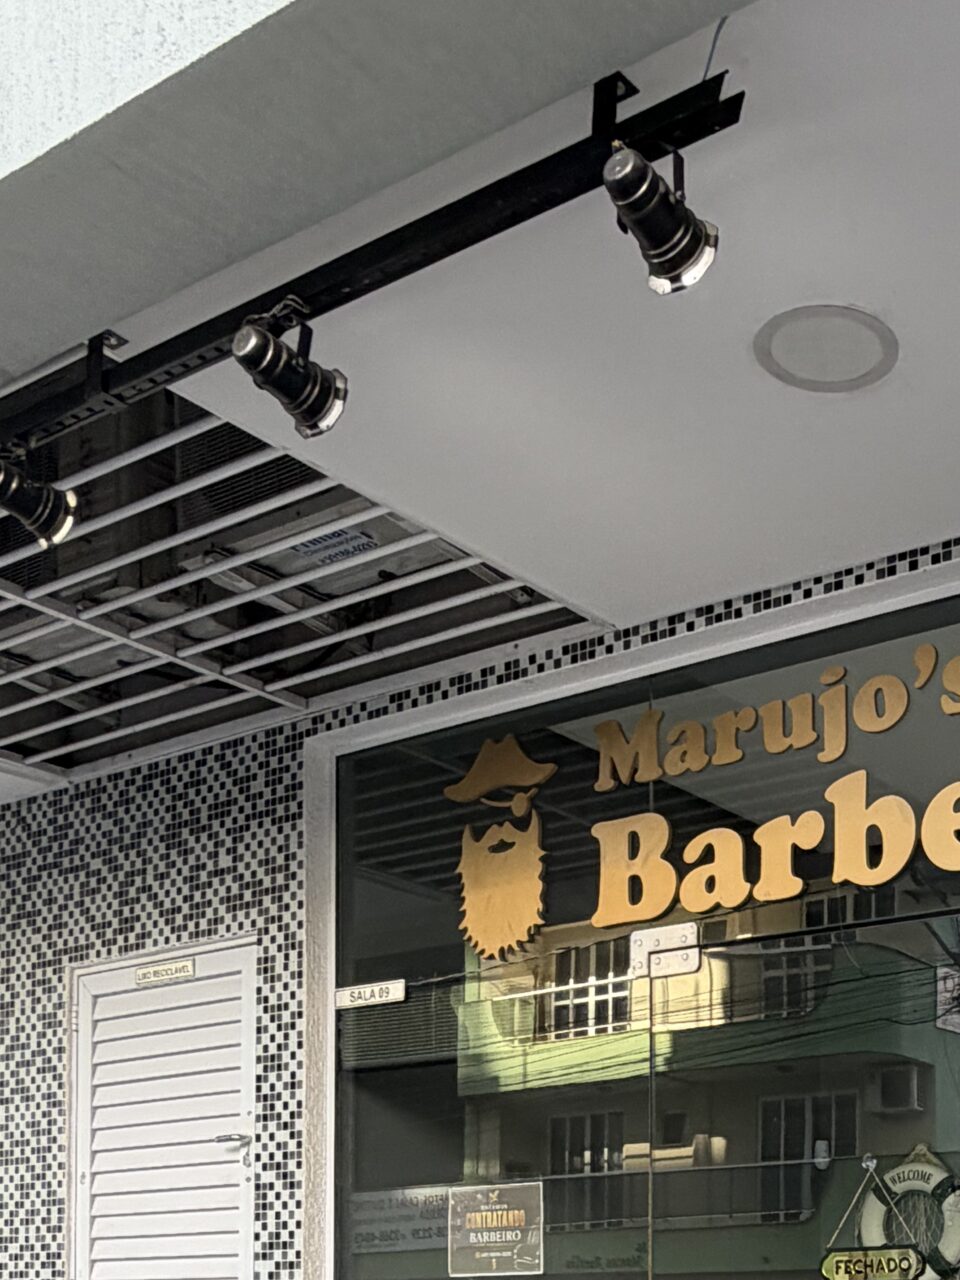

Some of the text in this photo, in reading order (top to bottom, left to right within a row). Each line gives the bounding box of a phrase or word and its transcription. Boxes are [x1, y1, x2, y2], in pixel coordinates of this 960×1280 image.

[349, 986, 390, 1004] SALA 09
[888, 1168, 934, 1186] WELCOME
[465, 1208, 526, 1230] CONTRATANDO
[469, 1229, 522, 1243] BARBEIRO
[835, 1255, 912, 1275] FECHADO
